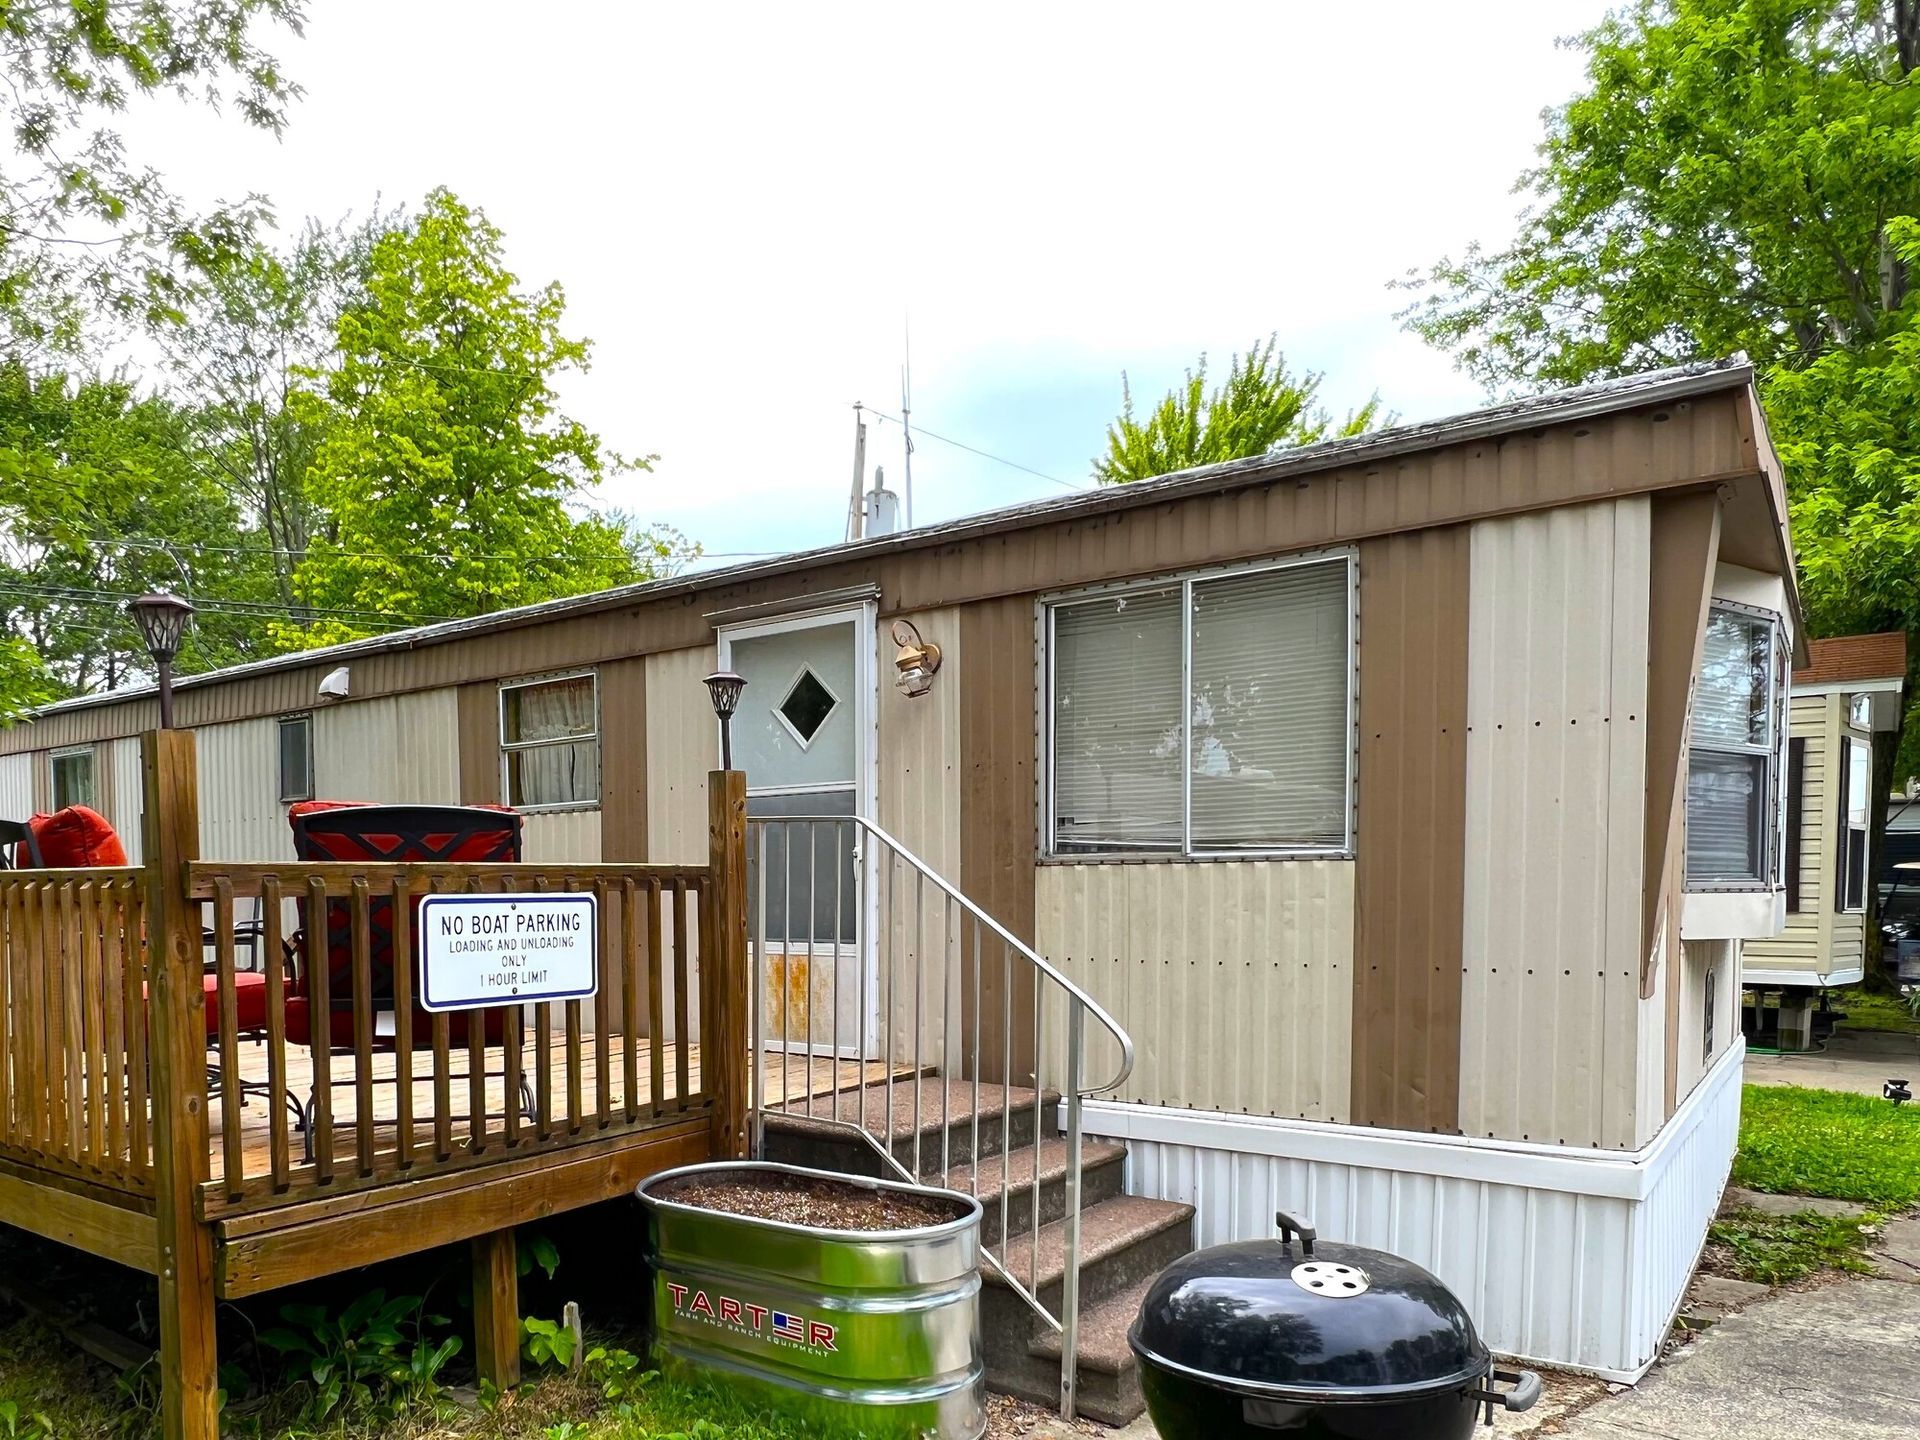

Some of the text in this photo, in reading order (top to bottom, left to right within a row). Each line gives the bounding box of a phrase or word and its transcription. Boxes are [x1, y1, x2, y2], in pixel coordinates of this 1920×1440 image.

[442, 914, 580, 935] NO BOAT PARKING
[450, 937, 574, 953] LOADING AND UNLOADING
[502, 955, 527, 967] ONLY
[480, 970, 548, 987] 1 HOUR LIMIT
[675, 1309, 829, 1358] FARM AND RANCH EQUIPMENT
